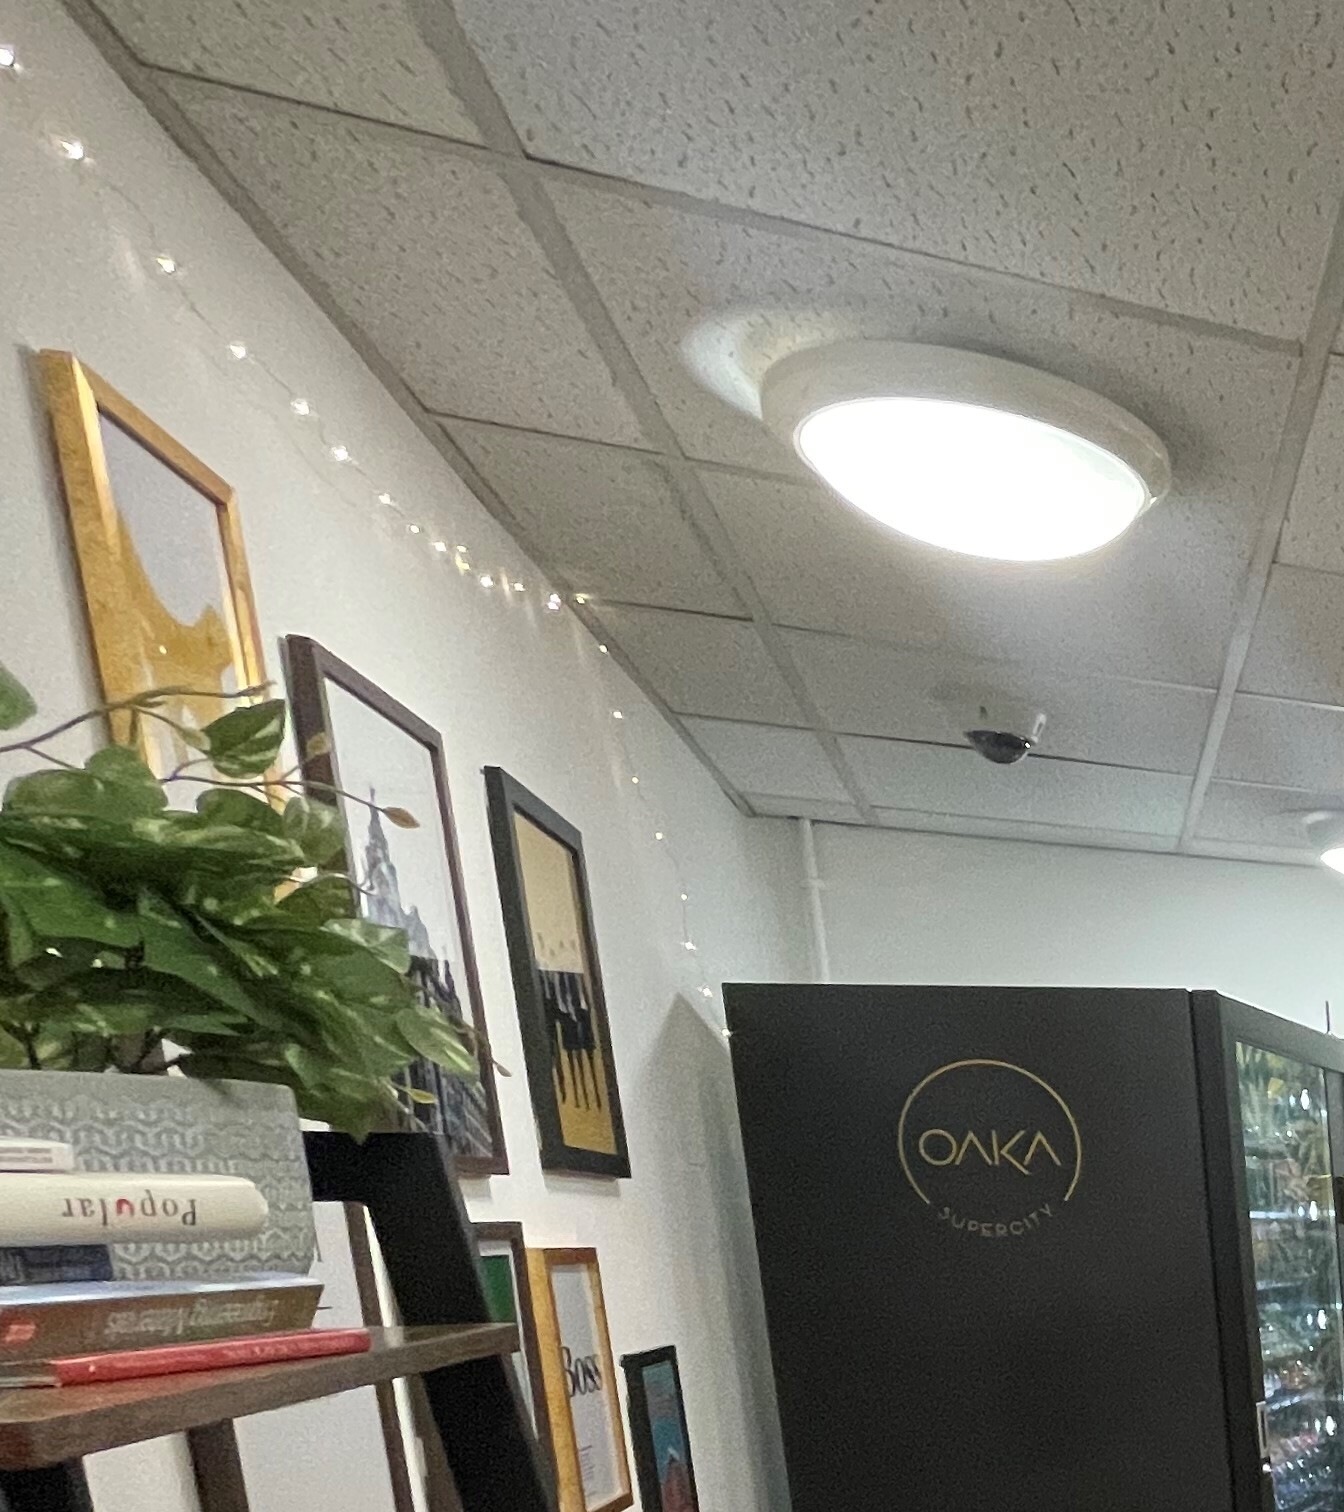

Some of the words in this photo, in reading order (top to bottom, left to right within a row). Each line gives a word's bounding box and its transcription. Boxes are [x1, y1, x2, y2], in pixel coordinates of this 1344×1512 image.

[918, 1128, 1062, 1176] OAKA
[61, 1189, 197, 1226] Popular
[937, 1203, 1054, 1237] SUPERCITY
